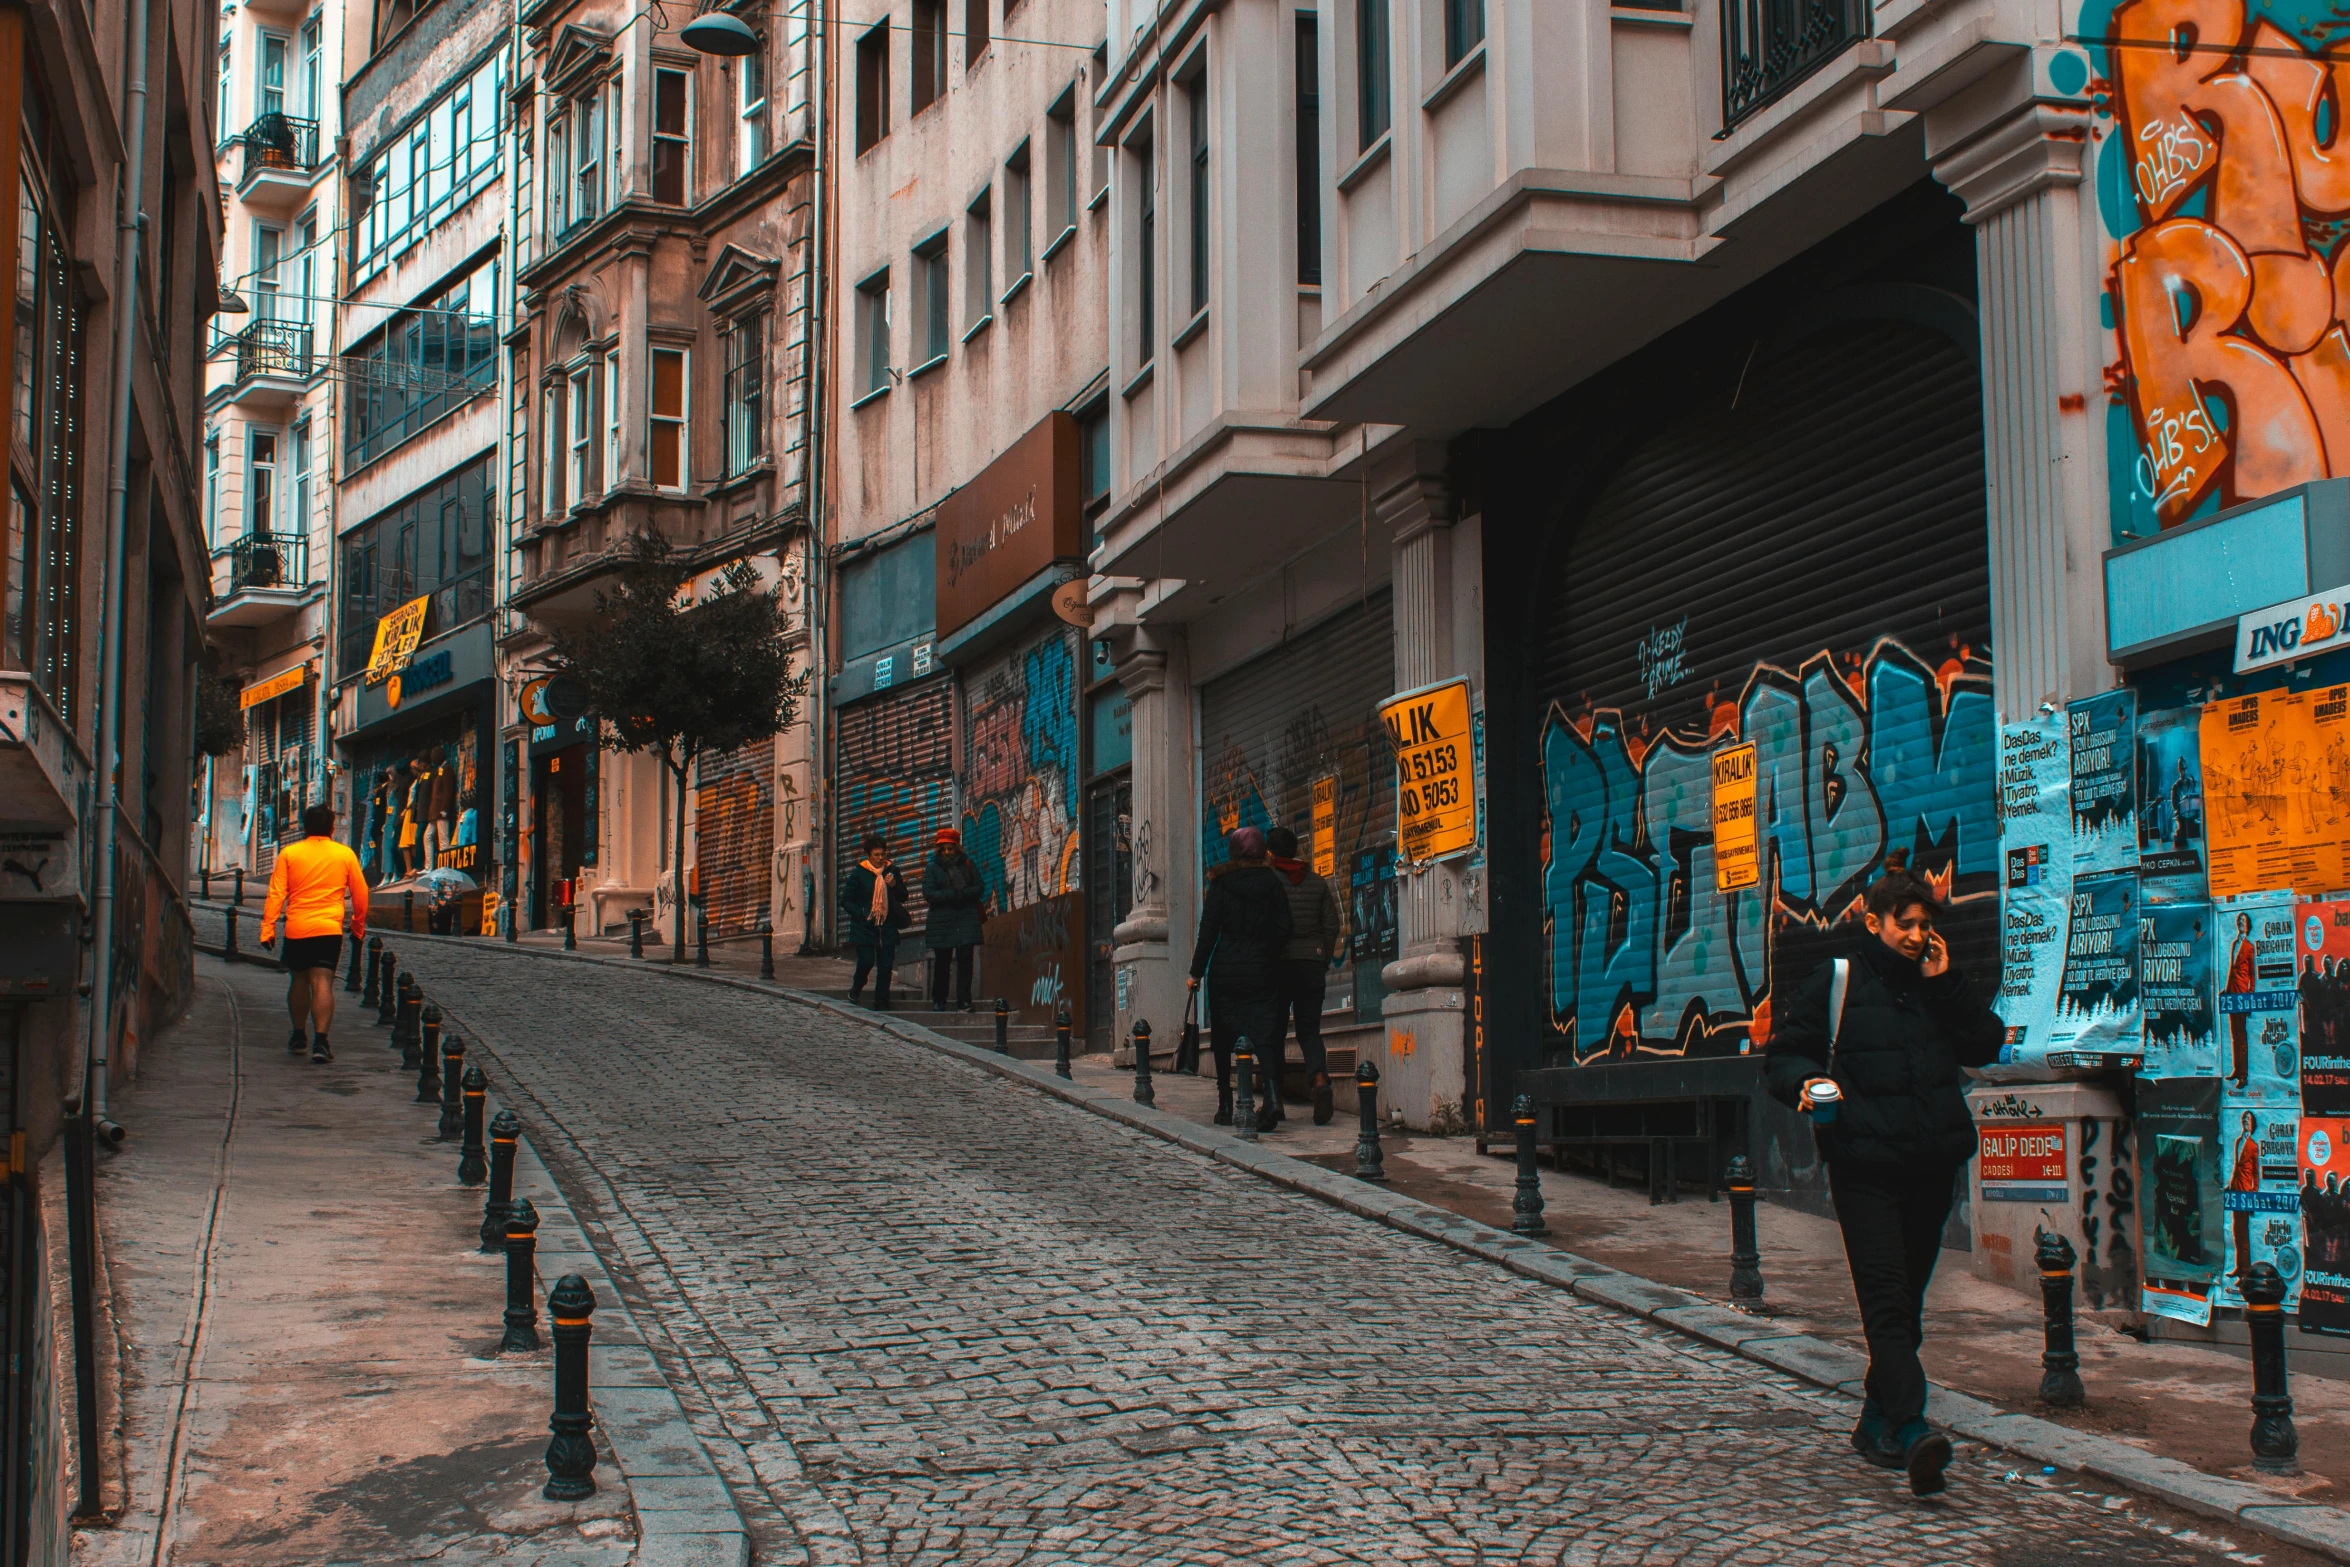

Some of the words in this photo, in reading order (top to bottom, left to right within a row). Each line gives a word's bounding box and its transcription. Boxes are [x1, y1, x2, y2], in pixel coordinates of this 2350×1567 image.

[2247, 615, 2301, 660] ING
[2241, 695, 2259, 711] OPUS
[2328, 686, 2348, 702] OPUS
[2228, 708, 2259, 727] AMADEUS
[2313, 699, 2347, 719] AMADEUS
[2071, 710, 2091, 737] SPX
[2003, 730, 2042, 751] DasDas
[1412, 743, 1457, 780] 5153
[2004, 754, 2017, 768] ne
[2017, 741, 2058, 766] demek?
[2074, 745, 2112, 776] ARIYOR!
[1715, 752, 1753, 787] KİRALIK
[2003, 765, 2037, 786] Müzik.
[1421, 776, 1459, 811] 5053
[2004, 799, 2042, 819] Yemek.
[437, 845, 477, 870] OUTLET
[1360, 852, 1375, 869] DANY
[2010, 856, 2025, 869] Das
[1351, 867, 1375, 888] BRILLANT
[2010, 867, 2026, 880] Das
[2073, 893, 2093, 917] SPX
[2005, 911, 2044, 930] DasDas
[2088, 913, 2121, 932] LOGOSUNU
[2333, 907, 2350, 927] ba
[2007, 934, 2019, 947] ne
[2019, 925, 2057, 946] demek?
[2264, 920, 2293, 939] GORAN
[2069, 930, 2113, 957] ARIYOR!
[2153, 941, 2191, 958] LOGOSUNU
[2005, 946, 2035, 965] Müzik.
[2001, 980, 2032, 998] Yemek.
[2220, 995, 2234, 1012] 25
[2237, 993, 2268, 1013] Şubat
[2271, 991, 2297, 1008] 2017
[2120, 1057, 2140, 1067] SPX
[2303, 1074, 2334, 1085] 14.02.17
[2268, 1122, 2295, 1141] GORAN
[1983, 1133, 2018, 1159] GALİP
[2020, 1136, 2053, 1158] DEDE
[1982, 1163, 2014, 1177] CADDESİ
[2223, 1192, 2238, 1208] 25
[2240, 1191, 2272, 1212] Şubat
[2275, 1194, 2300, 1212] 2017
[2267, 1219, 2292, 1236] bijelo
